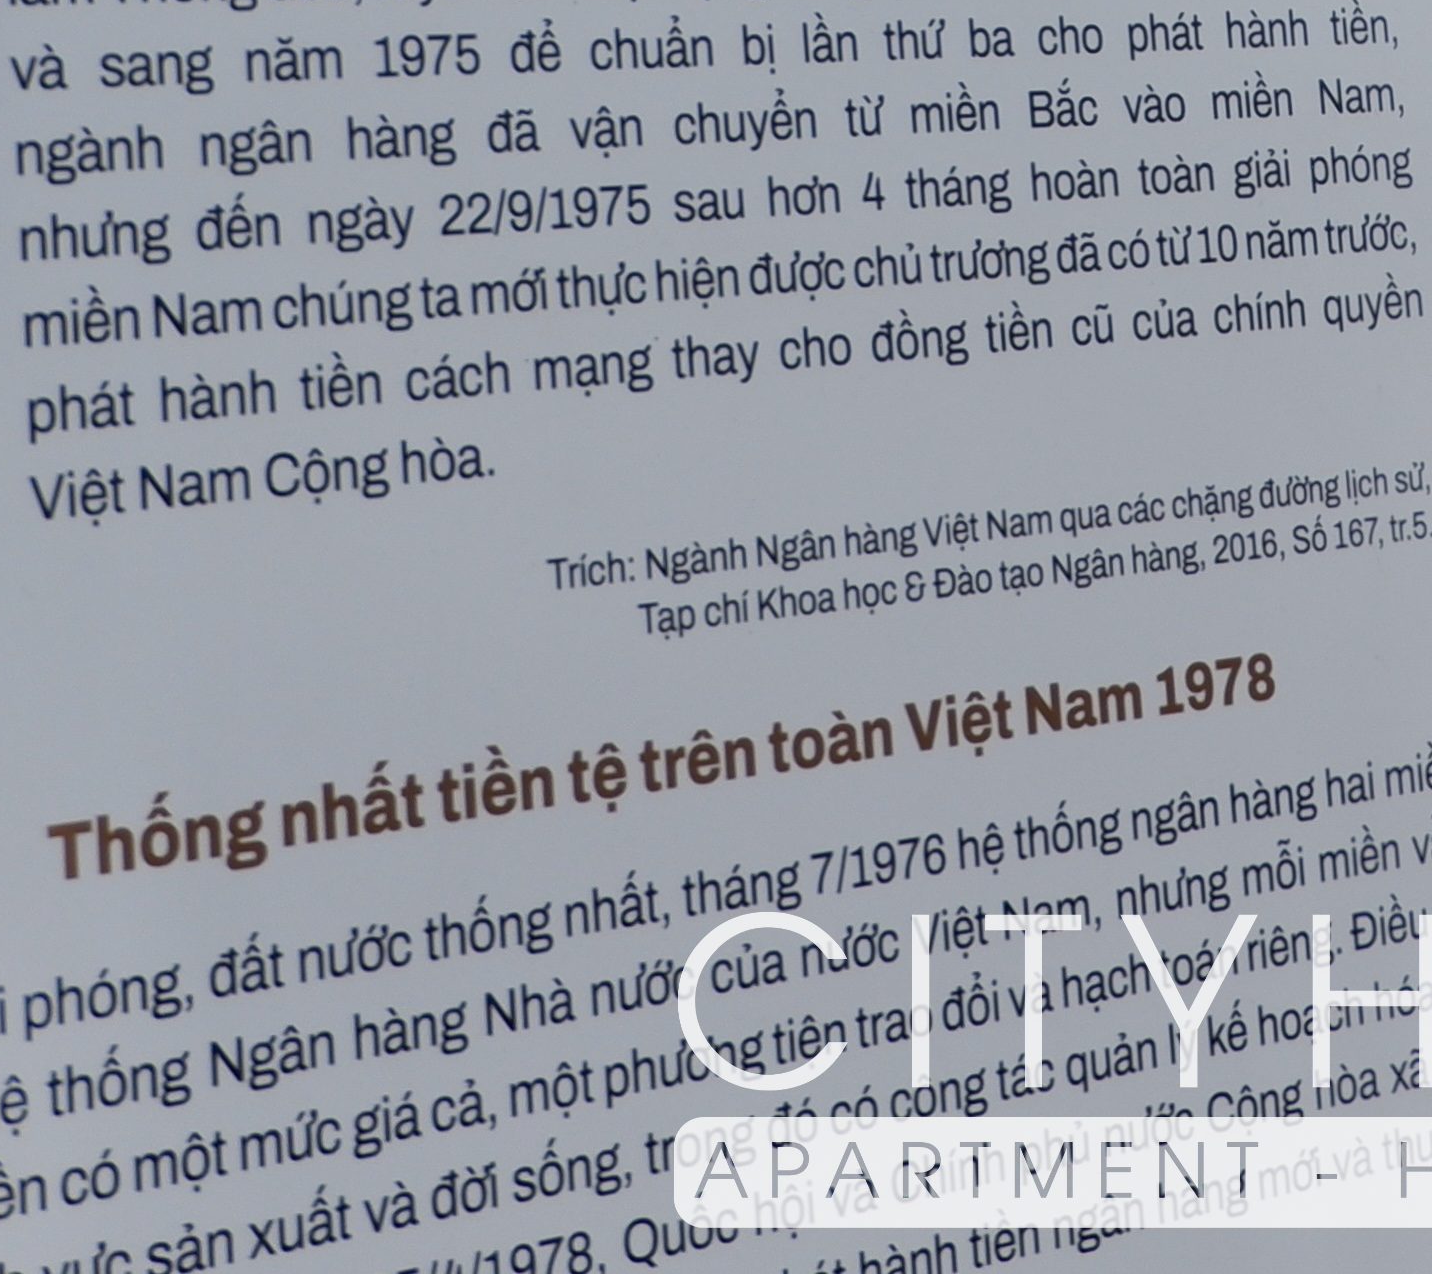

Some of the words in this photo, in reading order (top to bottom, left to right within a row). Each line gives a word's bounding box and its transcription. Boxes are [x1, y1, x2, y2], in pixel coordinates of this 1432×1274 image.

[546, 551, 635, 590] Trích:
[645, 538, 747, 585] Ngành
[756, 529, 836, 572] Ngân
[844, 522, 918, 558] hàng
[922, 512, 980, 551] Việt
[986, 509, 1053, 540] Nam
[1060, 504, 1112, 538] qua
[1118, 492, 1165, 525] các
[1172, 485, 1254, 522] chặng
[1259, 475, 1341, 509] đường
[1345, 467, 1388, 505] lịch
[1395, 462, 1430, 495] sử,
[637, 602, 696, 640] Tạp
[704, 590, 748, 627] chí
[757, 585, 837, 621] Khoa
[843, 578, 897, 615] học
[905, 571, 926, 602] &
[932, 564, 992, 599] Đào
[999, 561, 1044, 596] tạo
[1052, 548, 1124, 589] Ngân
[1131, 541, 1205, 575] hàng,
[1213, 529, 1285, 564] 2016,
[1293, 514, 1327, 554] Số
[1333, 516, 1383, 549] 167,
[47, 791, 268, 880] Thống
[281, 760, 425, 847] nhất
[437, 745, 554, 823] tiền
[567, 742, 627, 813] tệ
[639, 729, 756, 792] trên
[768, 710, 893, 773] toàn
[904, 690, 1014, 757] Việt
[1025, 682, 1143, 735] Nam
[1156, 653, 1275, 716] 1978
[23, 964, 194, 1043] phóng,
[208, 931, 286, 999] đất
[297, 923, 413, 984] nước
[425, 892, 552, 963] thống
[565, 869, 672, 936] nhất,
[680, 860, 803, 918] tháng
[809, 832, 947, 896] 7/1976
[956, 821, 1005, 876] hệ
[1013, 799, 1124, 861] thống
[1130, 790, 1220, 847] ngân
[1228, 775, 1319, 827] hàng
[1324, 760, 1376, 809] hai
